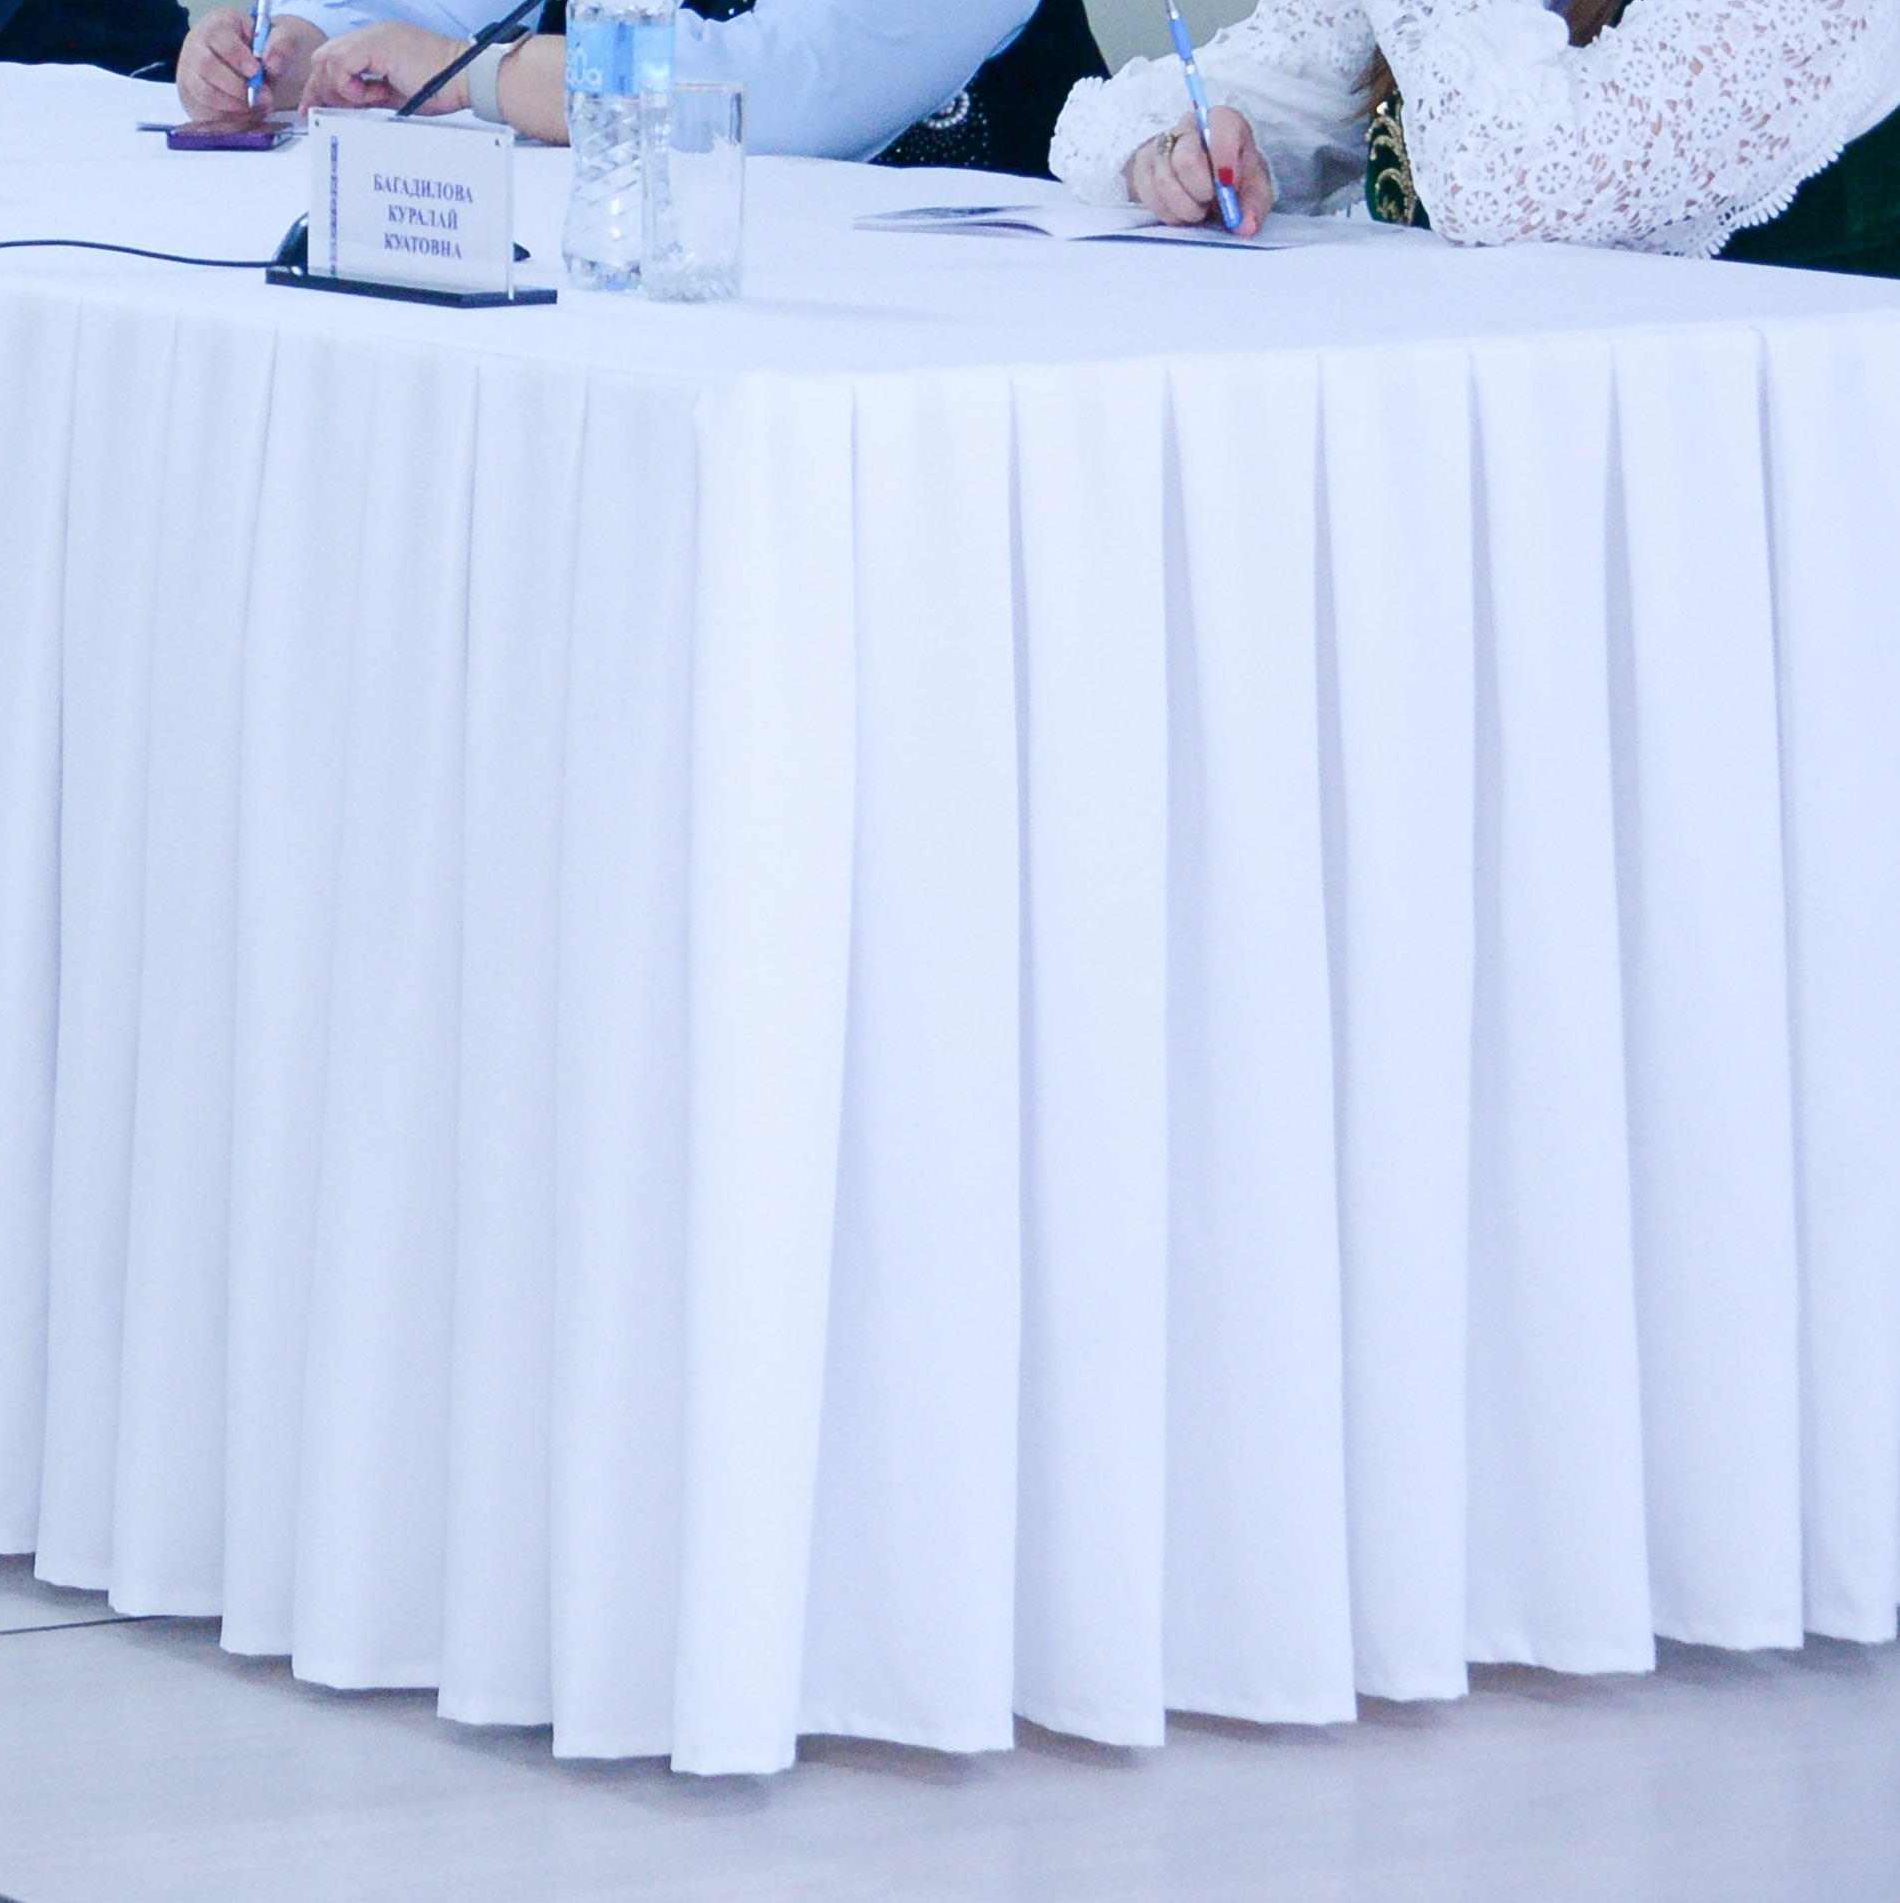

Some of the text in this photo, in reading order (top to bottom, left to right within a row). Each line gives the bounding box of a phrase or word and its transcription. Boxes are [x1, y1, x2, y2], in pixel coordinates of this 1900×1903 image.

[373, 173, 473, 203] БАГАДИЛОВА
[387, 204, 458, 230] КУРАЛАЙ
[384, 232, 462, 259] КУАТОВНА
